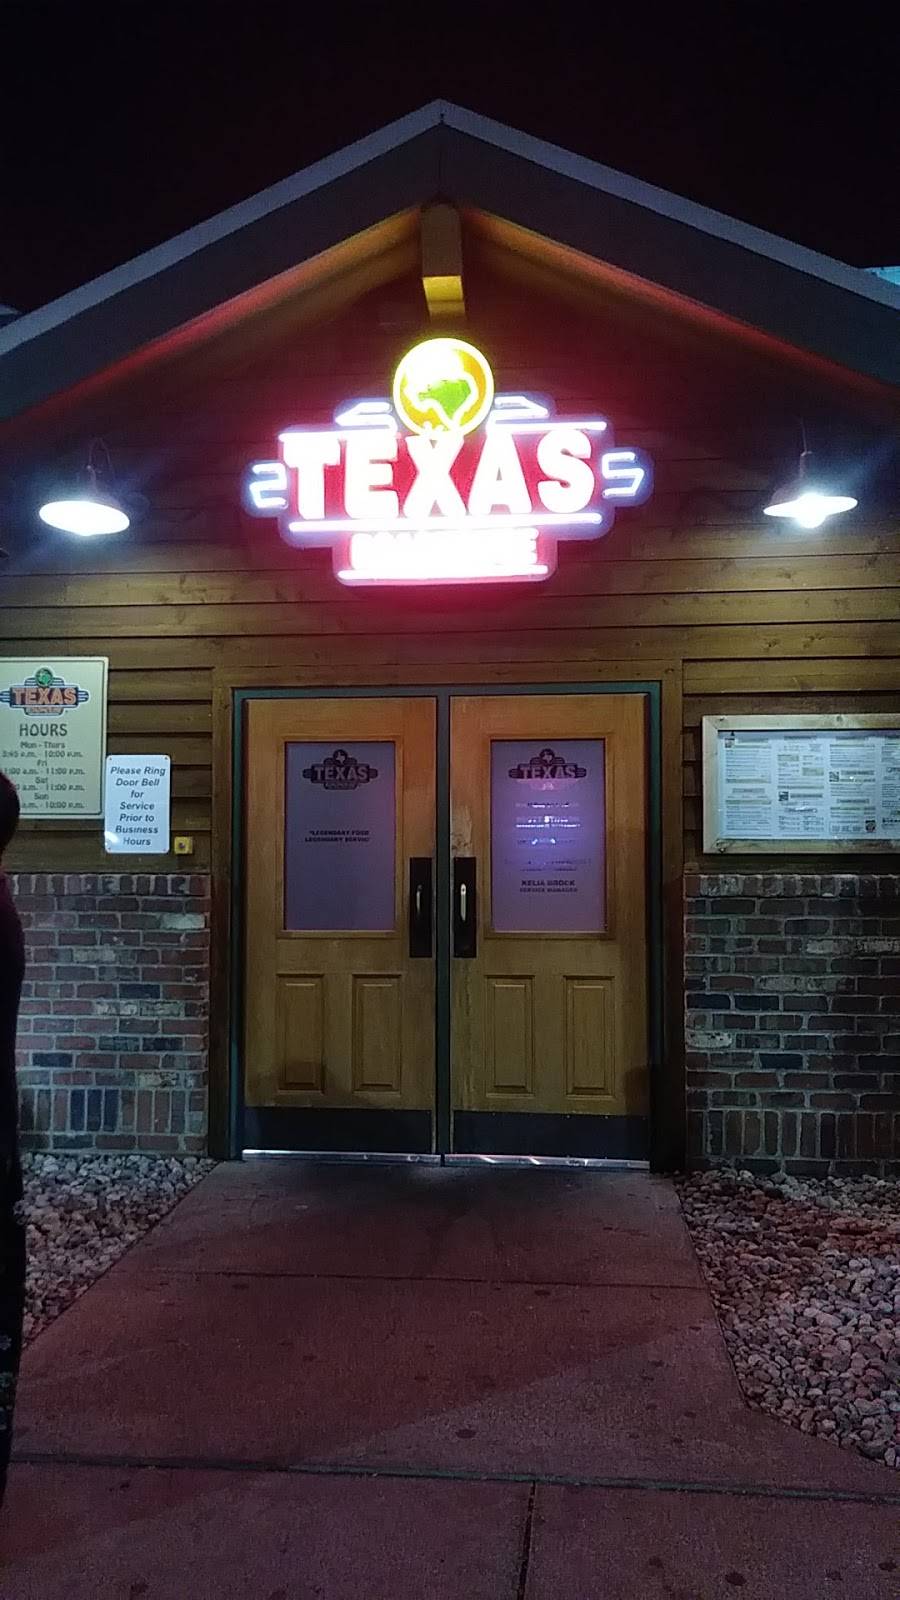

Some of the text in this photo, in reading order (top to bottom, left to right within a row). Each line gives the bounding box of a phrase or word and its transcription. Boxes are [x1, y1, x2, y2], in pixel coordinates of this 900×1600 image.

[283, 428, 595, 519] TEXAS
[12, 687, 76, 704] TEXAS
[19, 723, 68, 736] HOURS
[20, 741, 37, 749] Mon
[44, 741, 65, 749] Thurs
[44, 750, 65, 758] 10:00
[46, 767, 67, 775] 11:00
[110, 766, 166, 776] Please Ring
[314, 766, 368, 780] TEXAS
[520, 766, 577, 779] TEXAS
[115, 778, 160, 786] Door Bell
[130, 790, 144, 798] for
[45, 801, 67, 809] 10:00
[119, 801, 155, 810] Service
[119, 814, 155, 822] Prior to
[115, 825, 159, 834] Business
[122, 837, 151, 846] Hours
